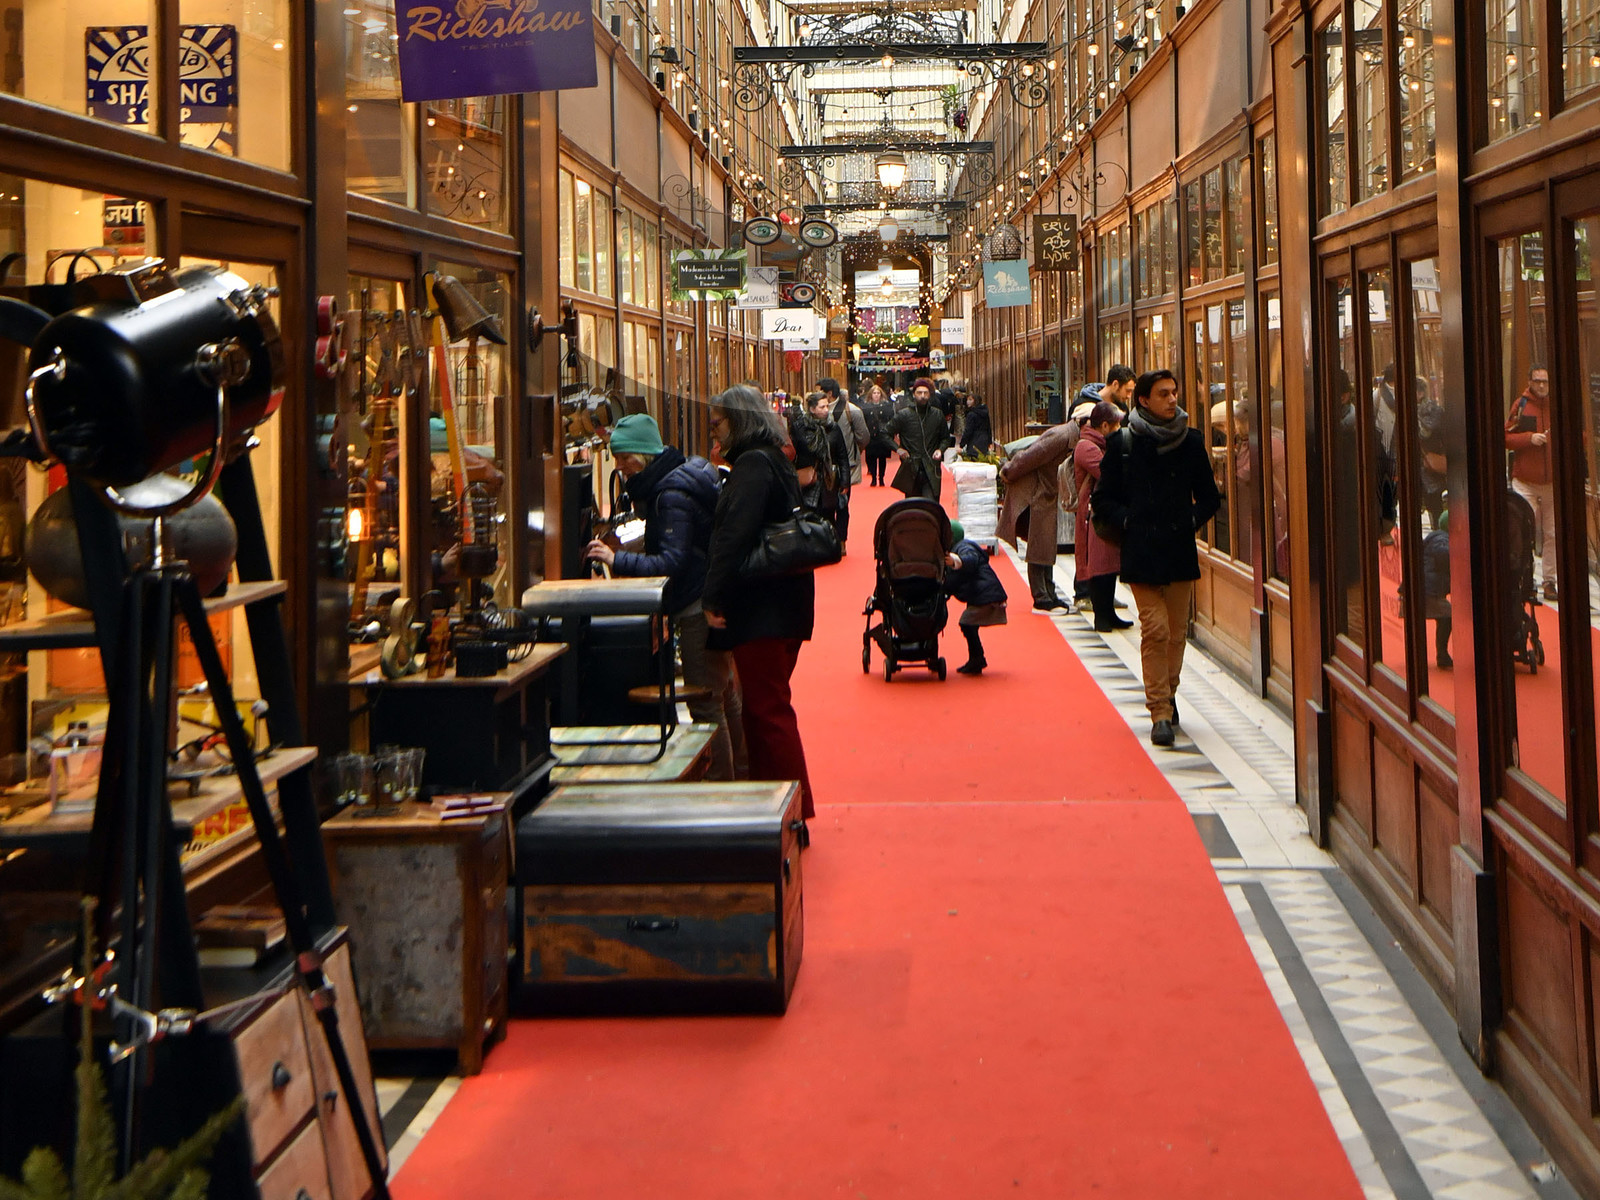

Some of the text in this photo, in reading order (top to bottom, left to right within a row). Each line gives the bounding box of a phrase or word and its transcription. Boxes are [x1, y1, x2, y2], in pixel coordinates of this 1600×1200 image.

[405, 0, 586, 42] Rickshaw
[106, 82, 217, 105] SHANG
[127, 107, 192, 123] SOP
[771, 317, 803, 333] Dear
